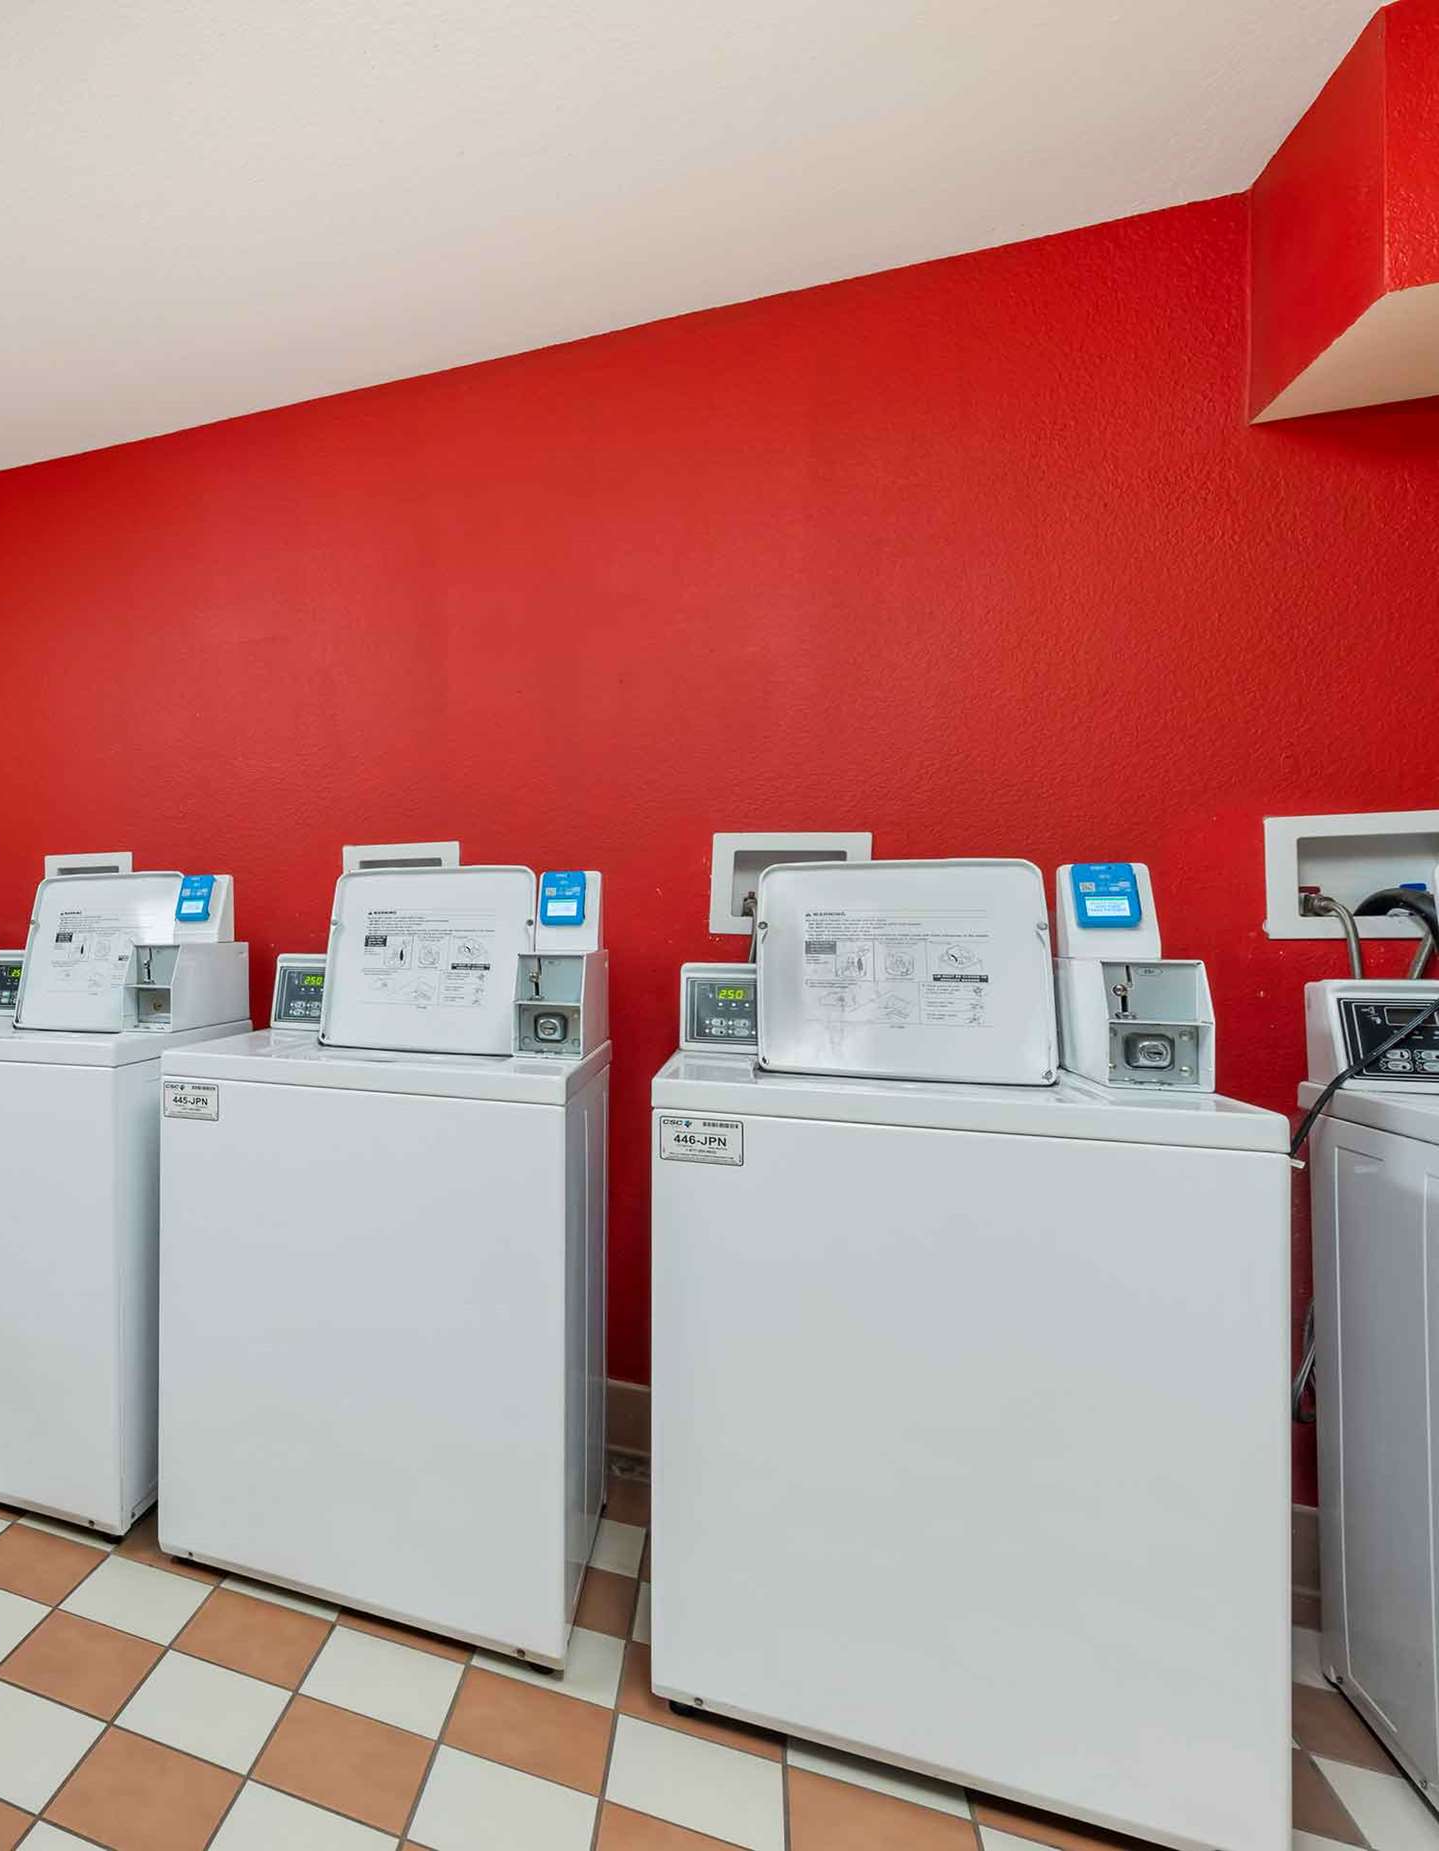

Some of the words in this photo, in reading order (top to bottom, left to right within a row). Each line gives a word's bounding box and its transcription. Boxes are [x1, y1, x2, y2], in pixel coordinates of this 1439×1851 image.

[719, 989, 744, 1000] 250
[172, 1096, 208, 1106] 445-JPN
[673, 1134, 727, 1147] 446-JPN
